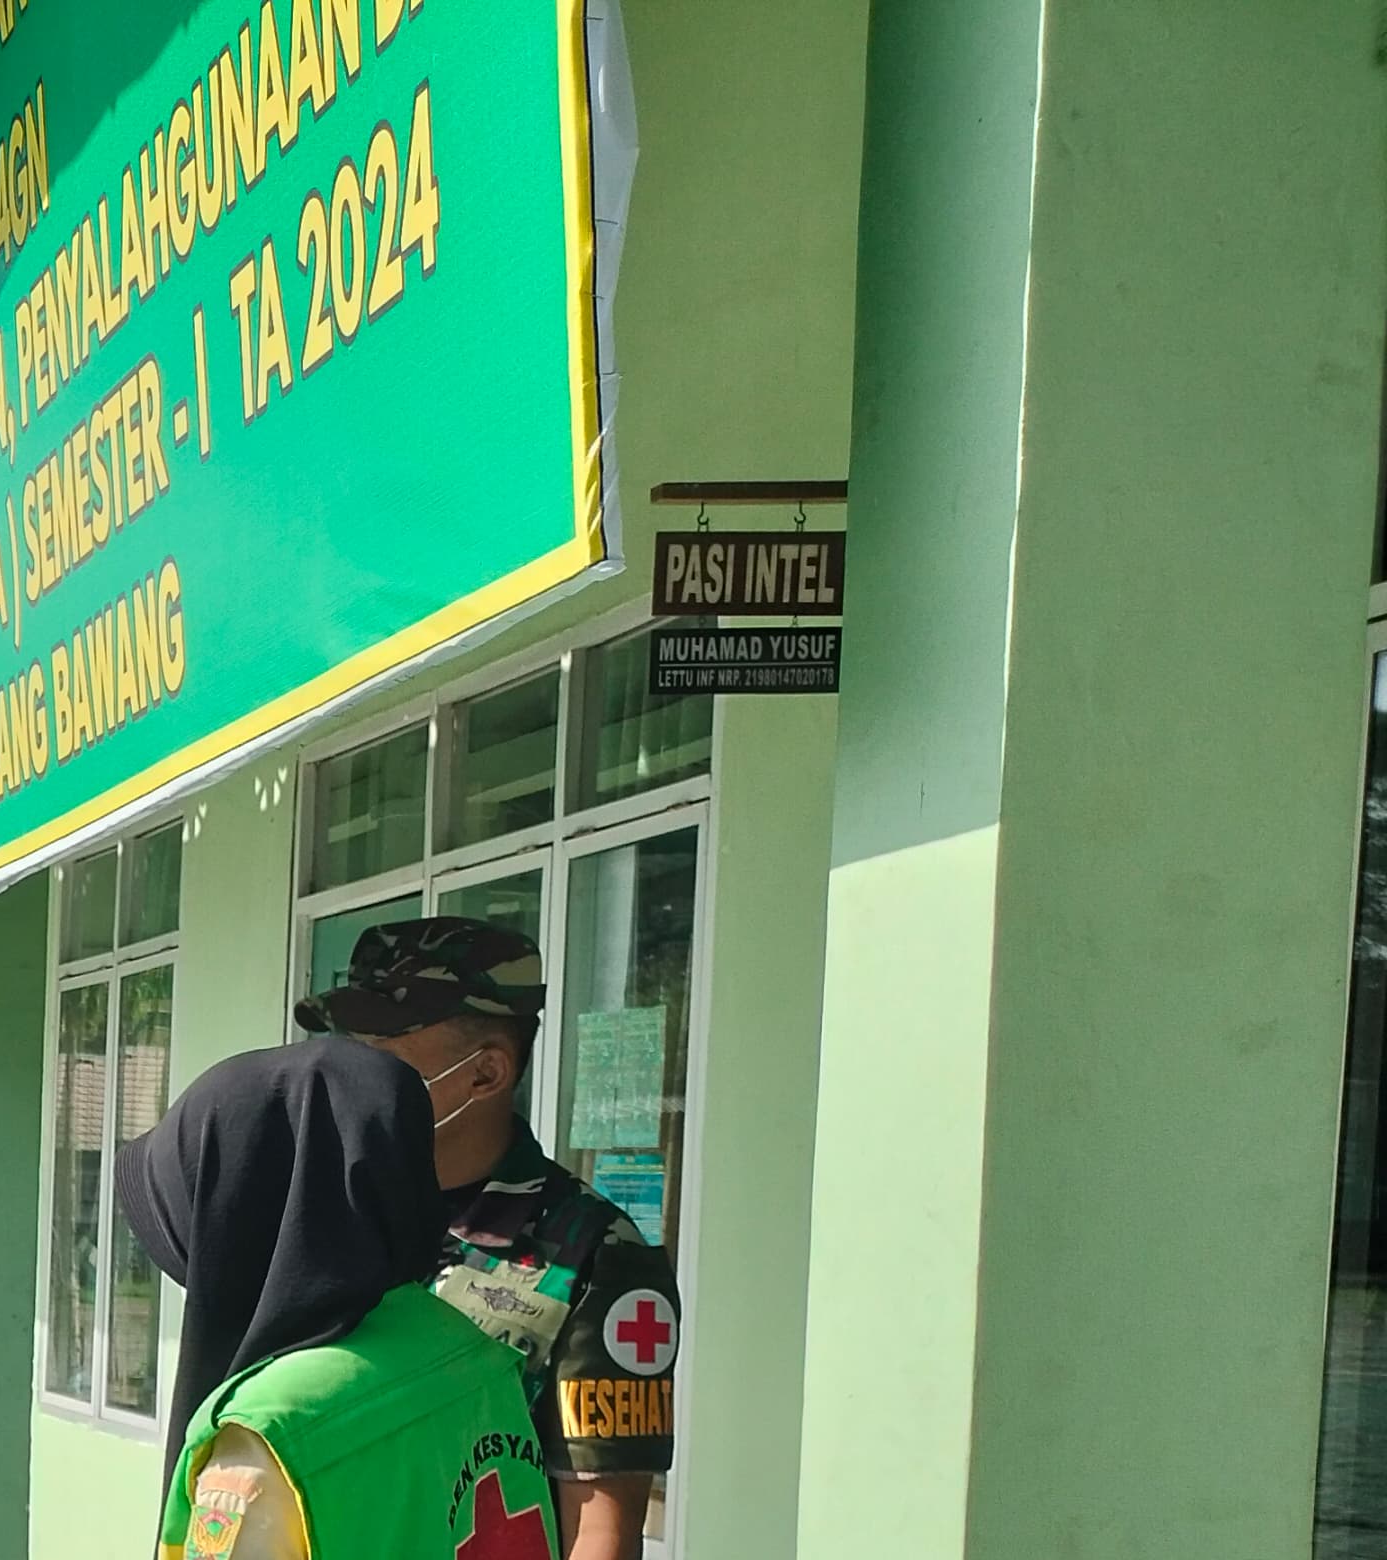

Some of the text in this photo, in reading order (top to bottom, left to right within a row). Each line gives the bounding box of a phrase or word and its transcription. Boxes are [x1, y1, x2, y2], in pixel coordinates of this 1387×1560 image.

[15, 0, 361, 429] PENYALAHGUNAAN
[23, 353, 170, 607] SEMESTER
[172, 397, 189, 449] -
[229, 234, 294, 427] TA
[297, 75, 441, 379] 2024
[665, 543, 835, 604] PASI INTEL
[51, 556, 186, 767] BAWANG
[658, 669, 693, 688] LETTU
[697, 669, 715, 687] INF
[718, 669, 742, 687] NRP.
[659, 634, 836, 662] MUHAMAD YUSUF
